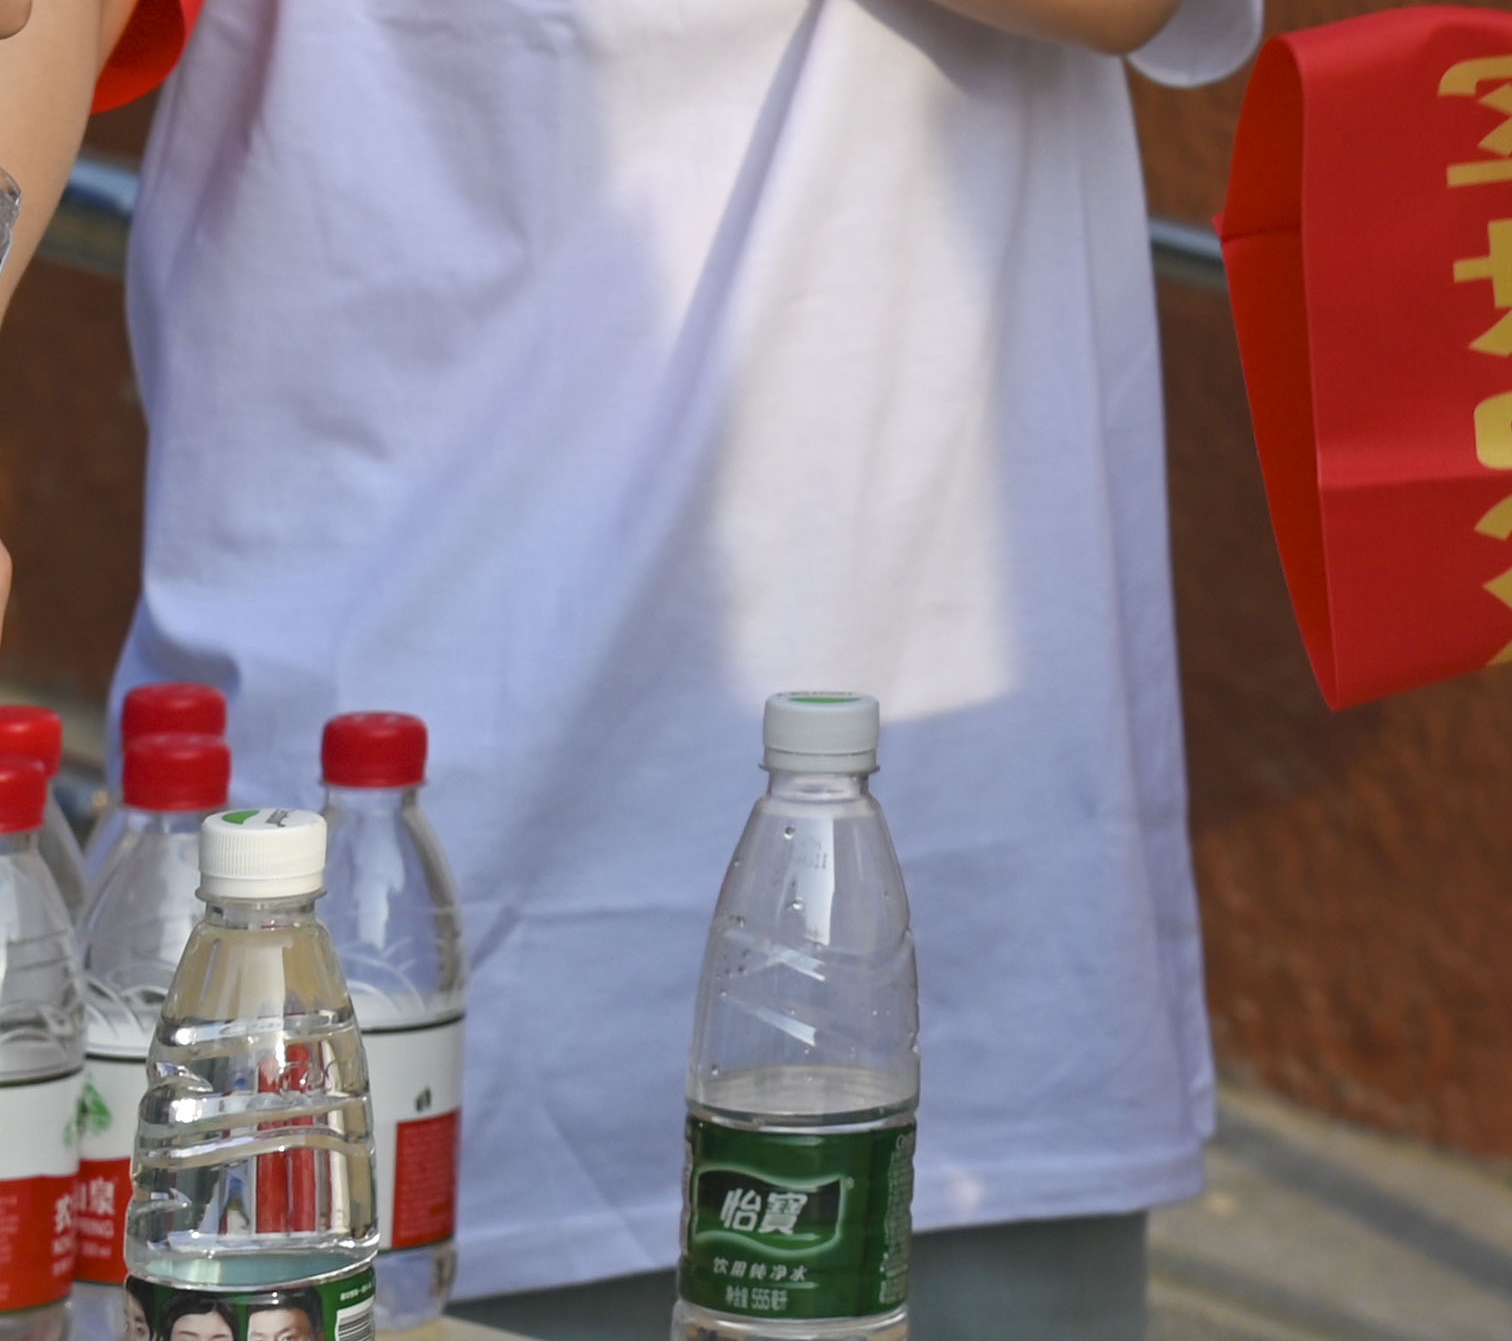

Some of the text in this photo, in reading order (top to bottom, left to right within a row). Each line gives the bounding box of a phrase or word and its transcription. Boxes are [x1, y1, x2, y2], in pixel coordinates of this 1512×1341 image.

[720, 1188, 809, 1236] 怡寶
[713, 1257, 808, 1281] 饮用纯净水
